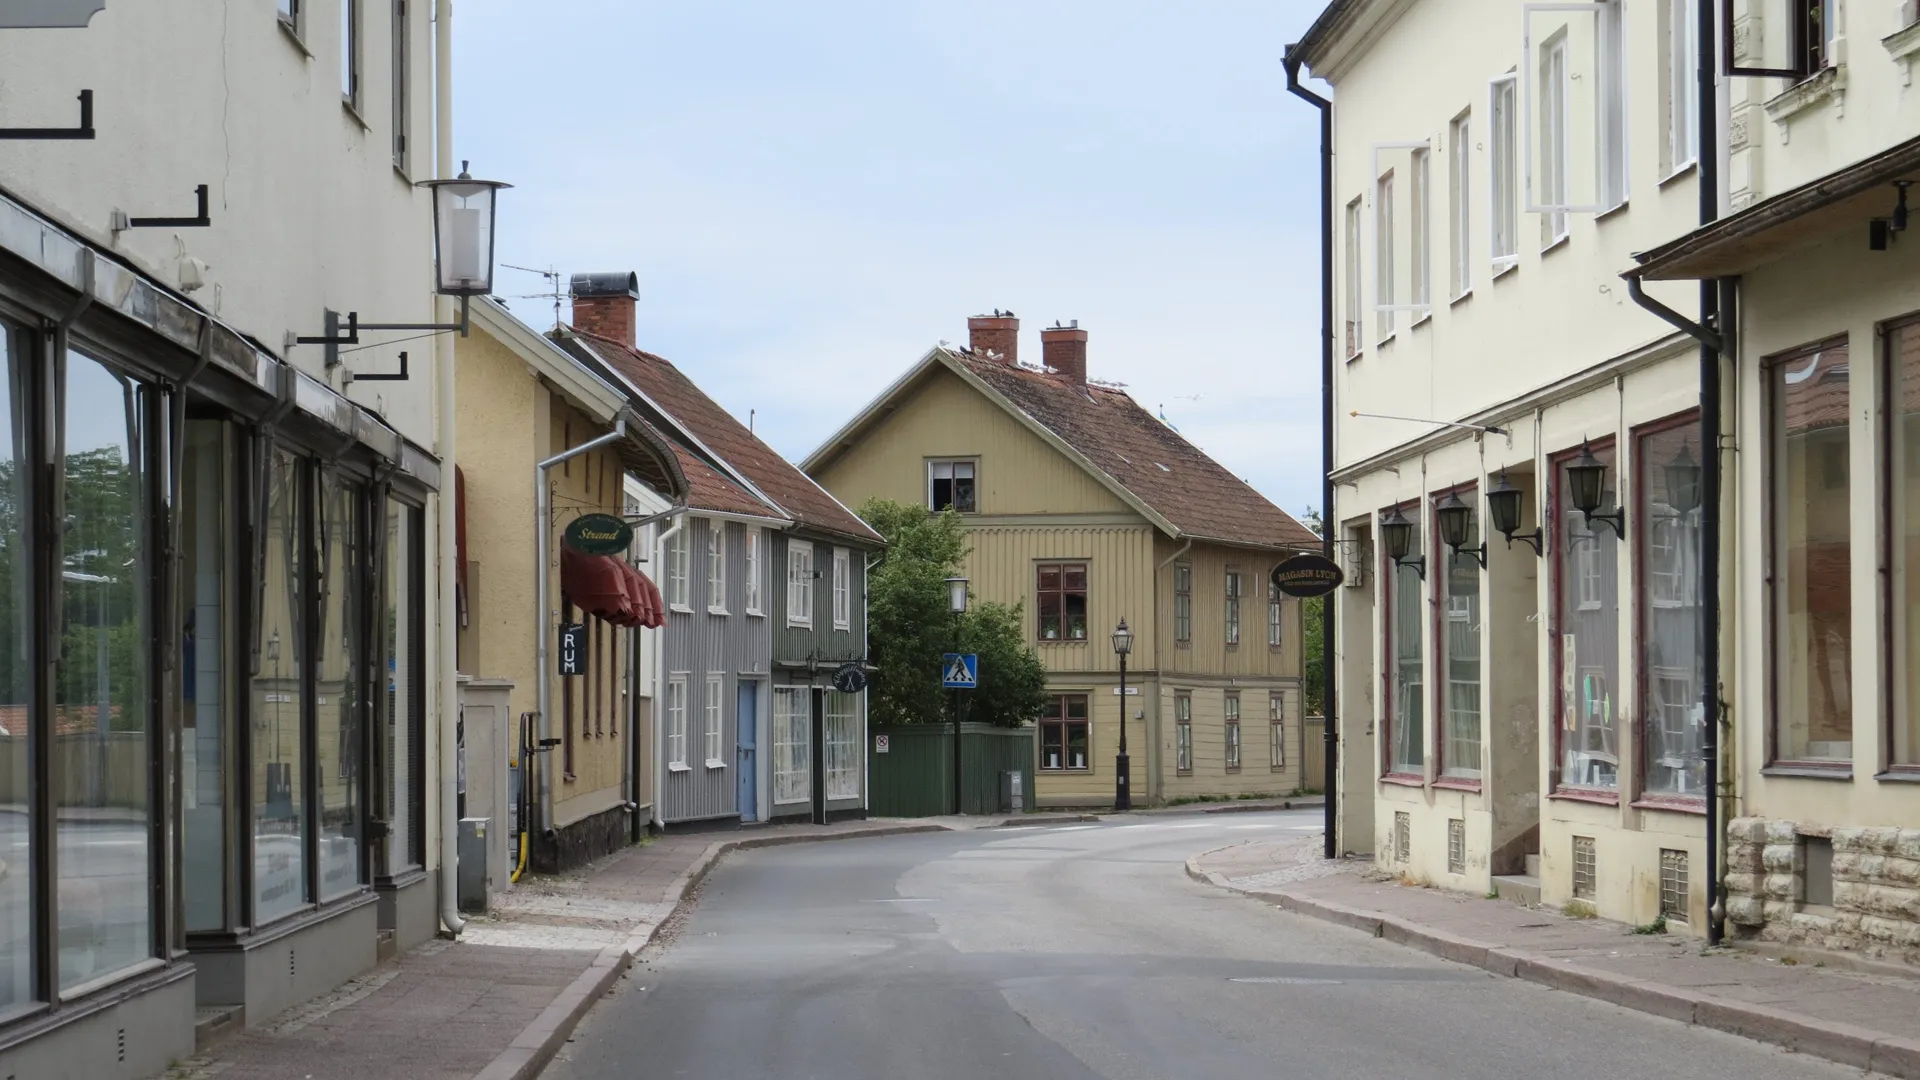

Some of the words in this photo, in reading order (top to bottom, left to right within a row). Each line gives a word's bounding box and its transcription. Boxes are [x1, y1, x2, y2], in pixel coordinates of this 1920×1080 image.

[579, 528, 619, 540] Strand
[1278, 569, 1313, 581] MAGASIN
[1315, 569, 1337, 580] LYON
[564, 634, 575, 673] RUM
